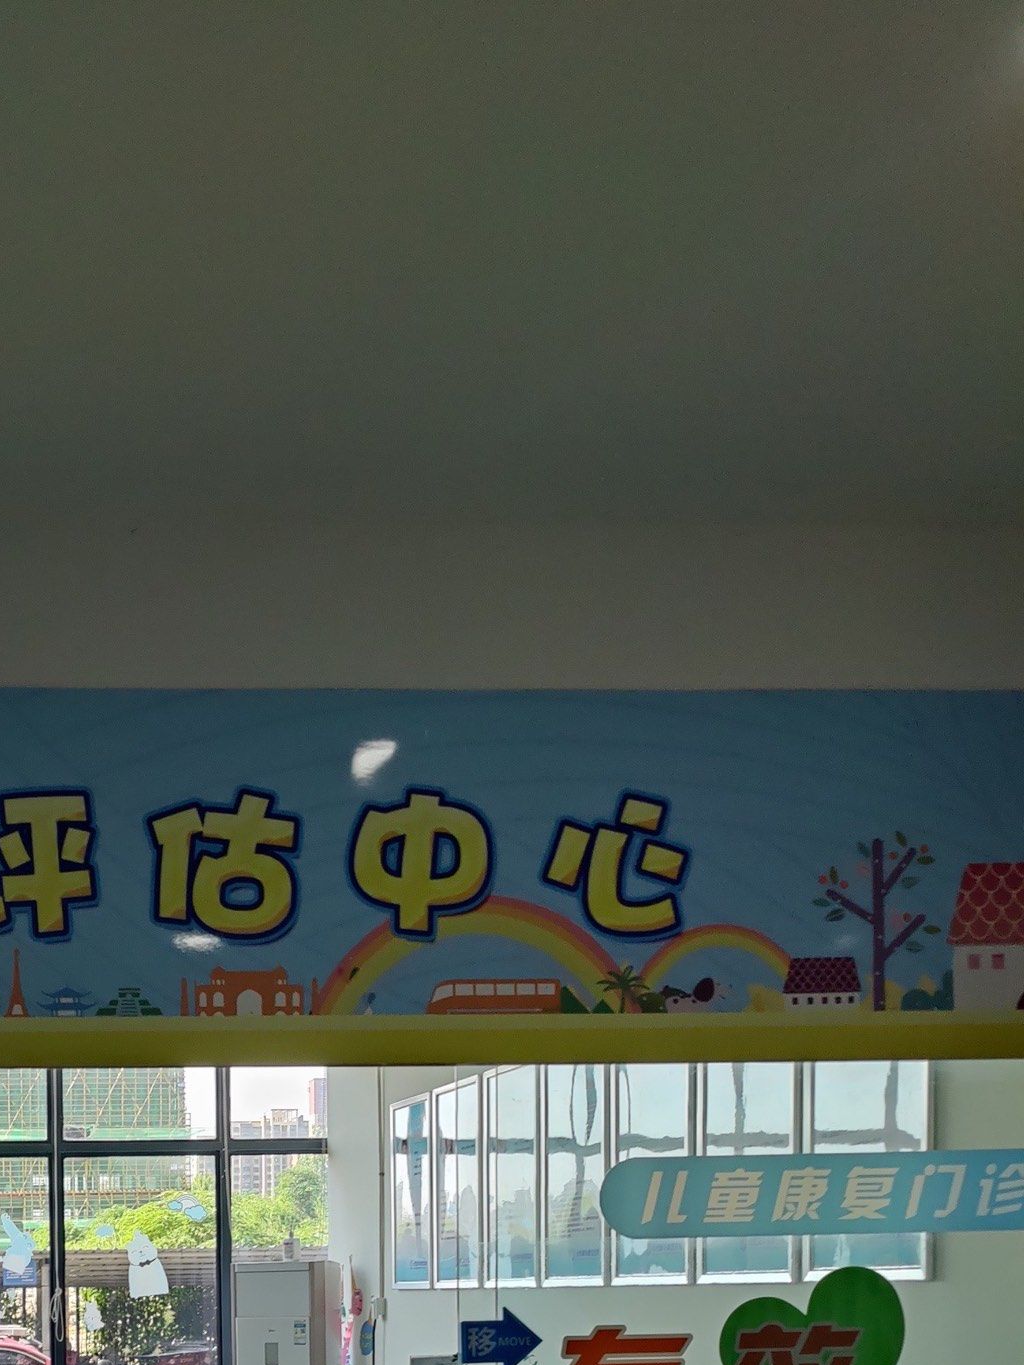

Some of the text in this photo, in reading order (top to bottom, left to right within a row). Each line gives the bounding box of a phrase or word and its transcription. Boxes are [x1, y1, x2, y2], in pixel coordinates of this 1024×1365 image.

[641, 1165, 1024, 1225] 儿童康复门诊
[467, 1326, 532, 1357] 移 MOVE
